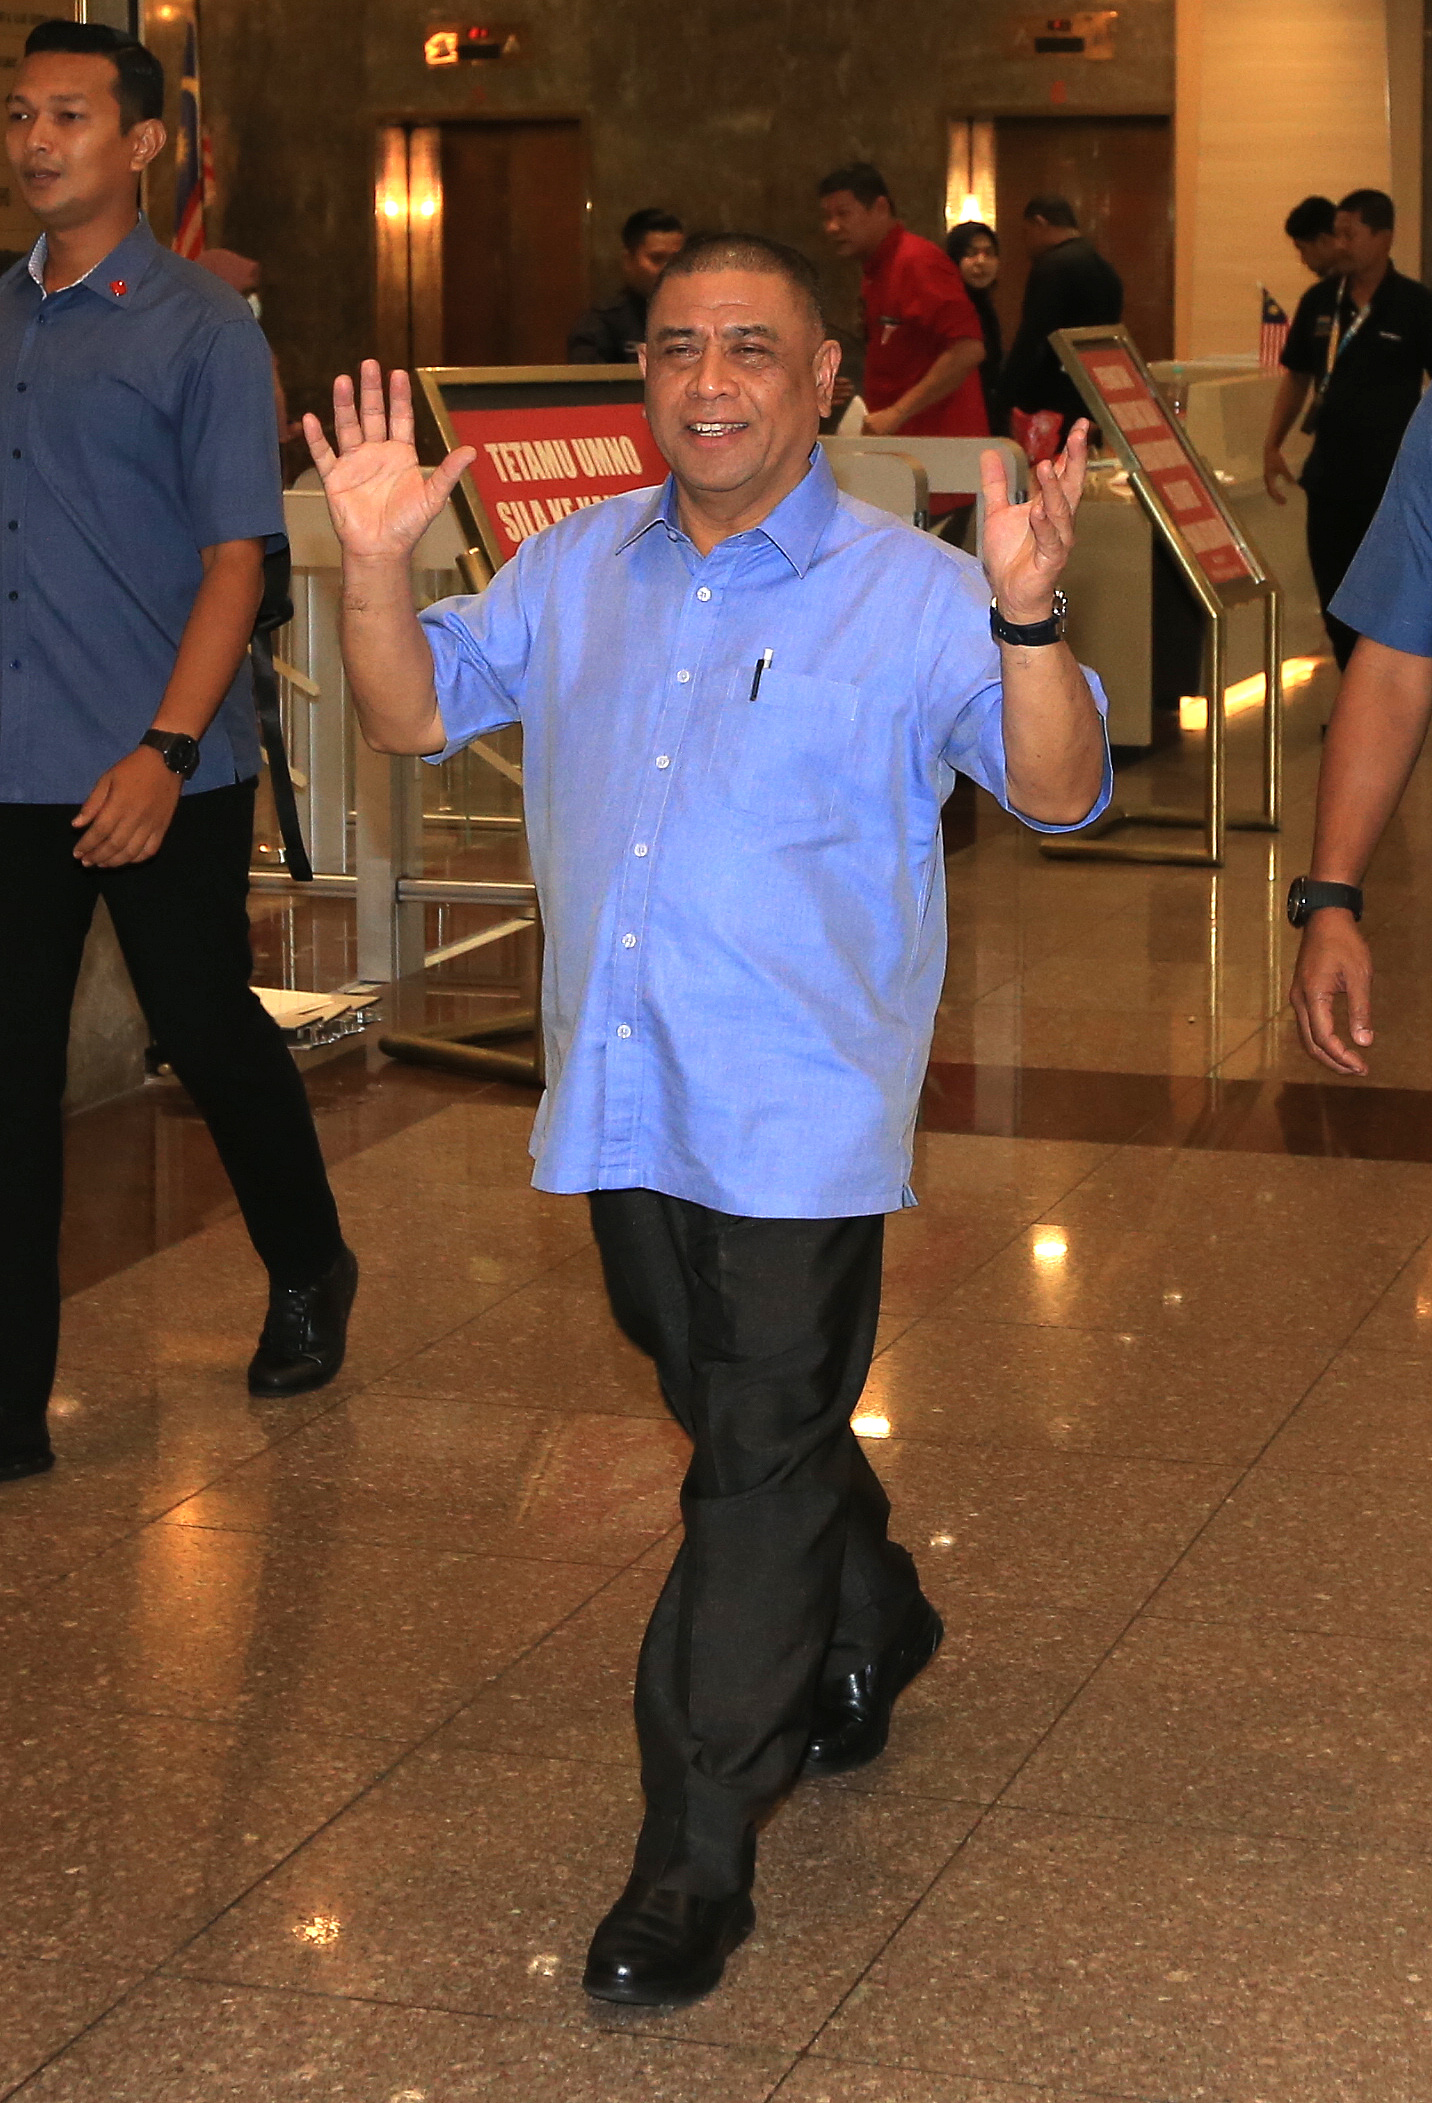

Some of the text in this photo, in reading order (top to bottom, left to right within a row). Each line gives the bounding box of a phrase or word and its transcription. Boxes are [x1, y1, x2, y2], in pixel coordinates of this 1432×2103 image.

[484, 435, 643, 482] TETAMU UMNO
[496, 499, 550, 543] SILA
